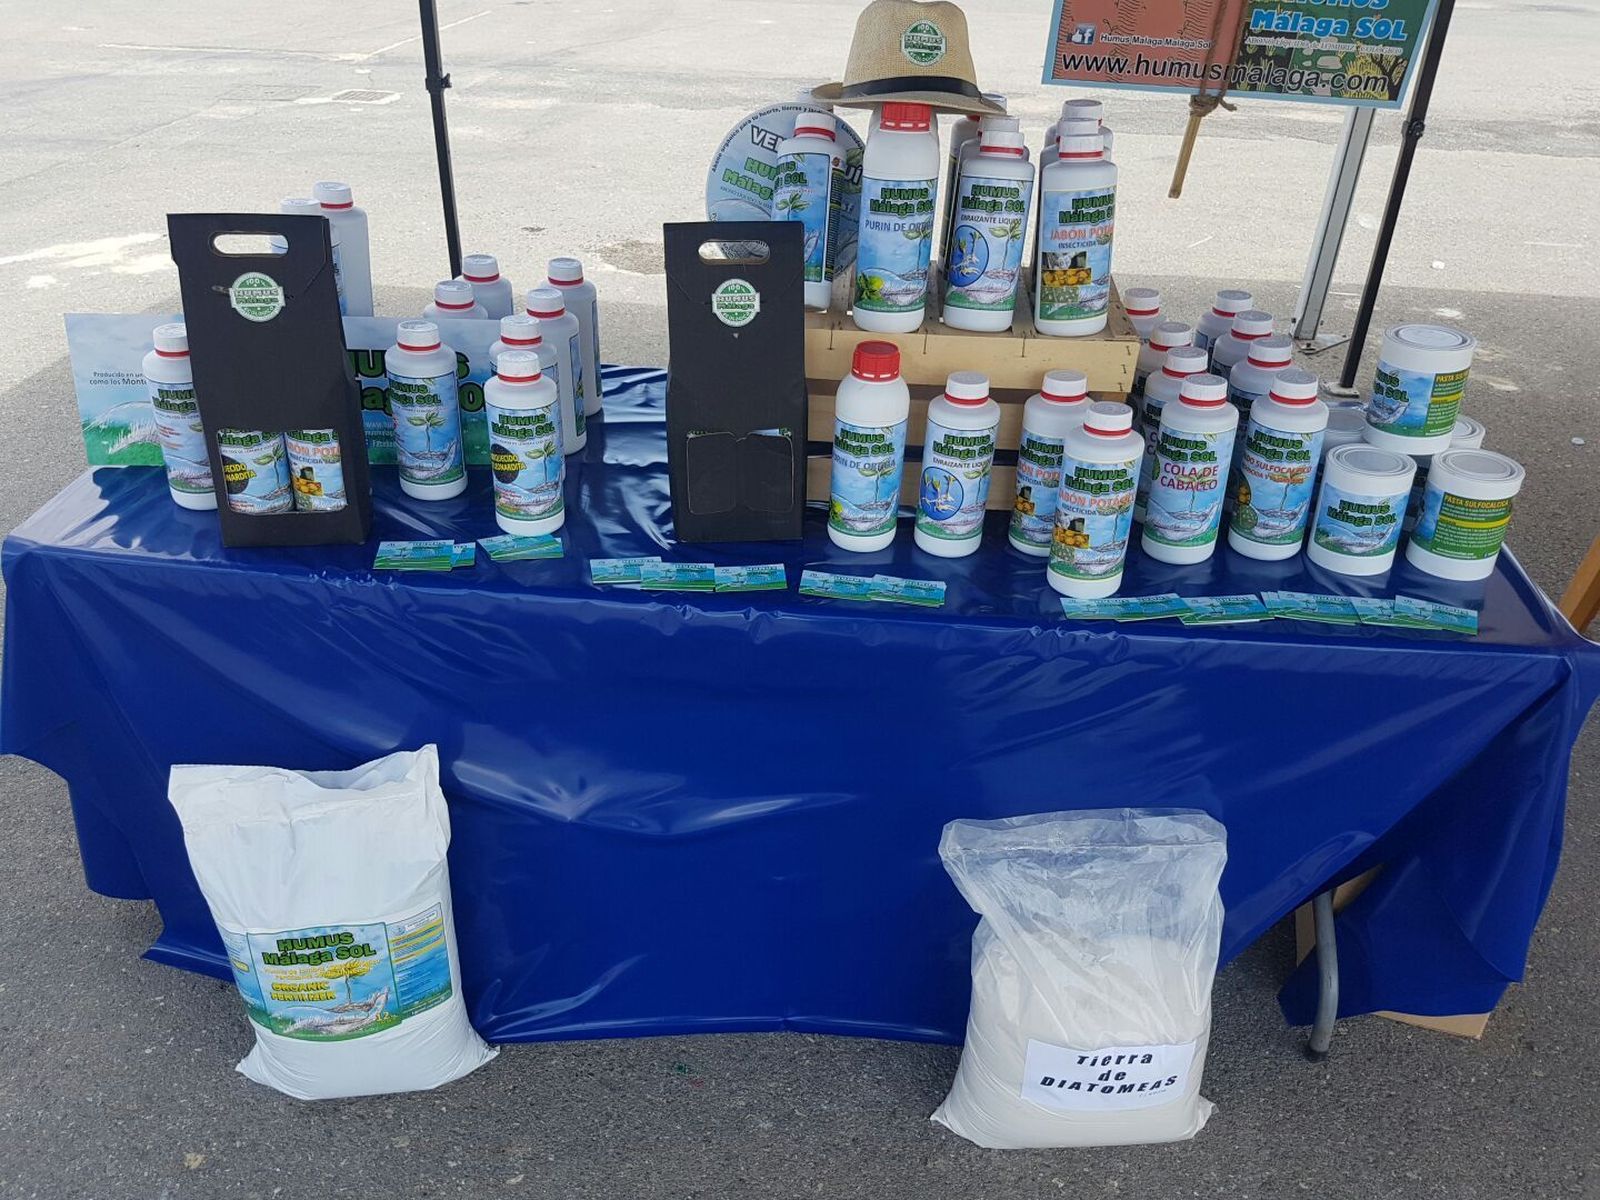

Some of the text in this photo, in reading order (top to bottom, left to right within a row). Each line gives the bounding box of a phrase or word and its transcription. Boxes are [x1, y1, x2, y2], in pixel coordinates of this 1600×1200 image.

[1250, 8, 1407, 41] Málaga SOL
[1100, 34, 1130, 43] Humus
[1131, 36, 1162, 48] Malaga
[1164, 39, 1195, 50] Malaga
[1062, 53, 1390, 93] www.humusmalaga.com
[784, 172, 808, 186] SOL
[880, 187, 929, 201] HUMUS
[970, 185, 1020, 199] HUMUS
[869, 199, 915, 217] Málaga
[960, 196, 1003, 216] Málaga
[1059, 207, 1105, 225] Málaga
[893, 221, 907, 232] DE
[415, 394, 442, 405] SOL
[1384, 386, 1410, 402] SOL
[499, 413, 546, 426] HUMUS
[840, 427, 885, 444] HUMUS
[944, 434, 990, 448] HUMUS
[1253, 430, 1304, 449] HUMUS
[870, 443, 896, 455] SOL
[932, 441, 977, 460] Málaga
[1189, 451, 1218, 462] SOL
[1286, 450, 1311, 462] SOL
[849, 460, 862, 470] DE
[1164, 462, 1220, 478] COLA DE
[1074, 466, 1127, 481] HUMUS
[1065, 473, 1110, 494] Málaga
[1161, 475, 1218, 491] CABALLO
[1339, 499, 1391, 515] HUMUS
[1445, 495, 1464, 505] PASTA
[1327, 506, 1398, 527] Málaga SOL
[276, 931, 355, 952] HUMUS
[261, 943, 378, 967] Málaga SOL
[271, 981, 330, 993] ORGANIC
[270, 991, 337, 1003] FERTILIZER
[1076, 1053, 1153, 1067] Tierra
[1098, 1069, 1127, 1082] de
[1039, 1075, 1178, 1094] DIATOMEAS
